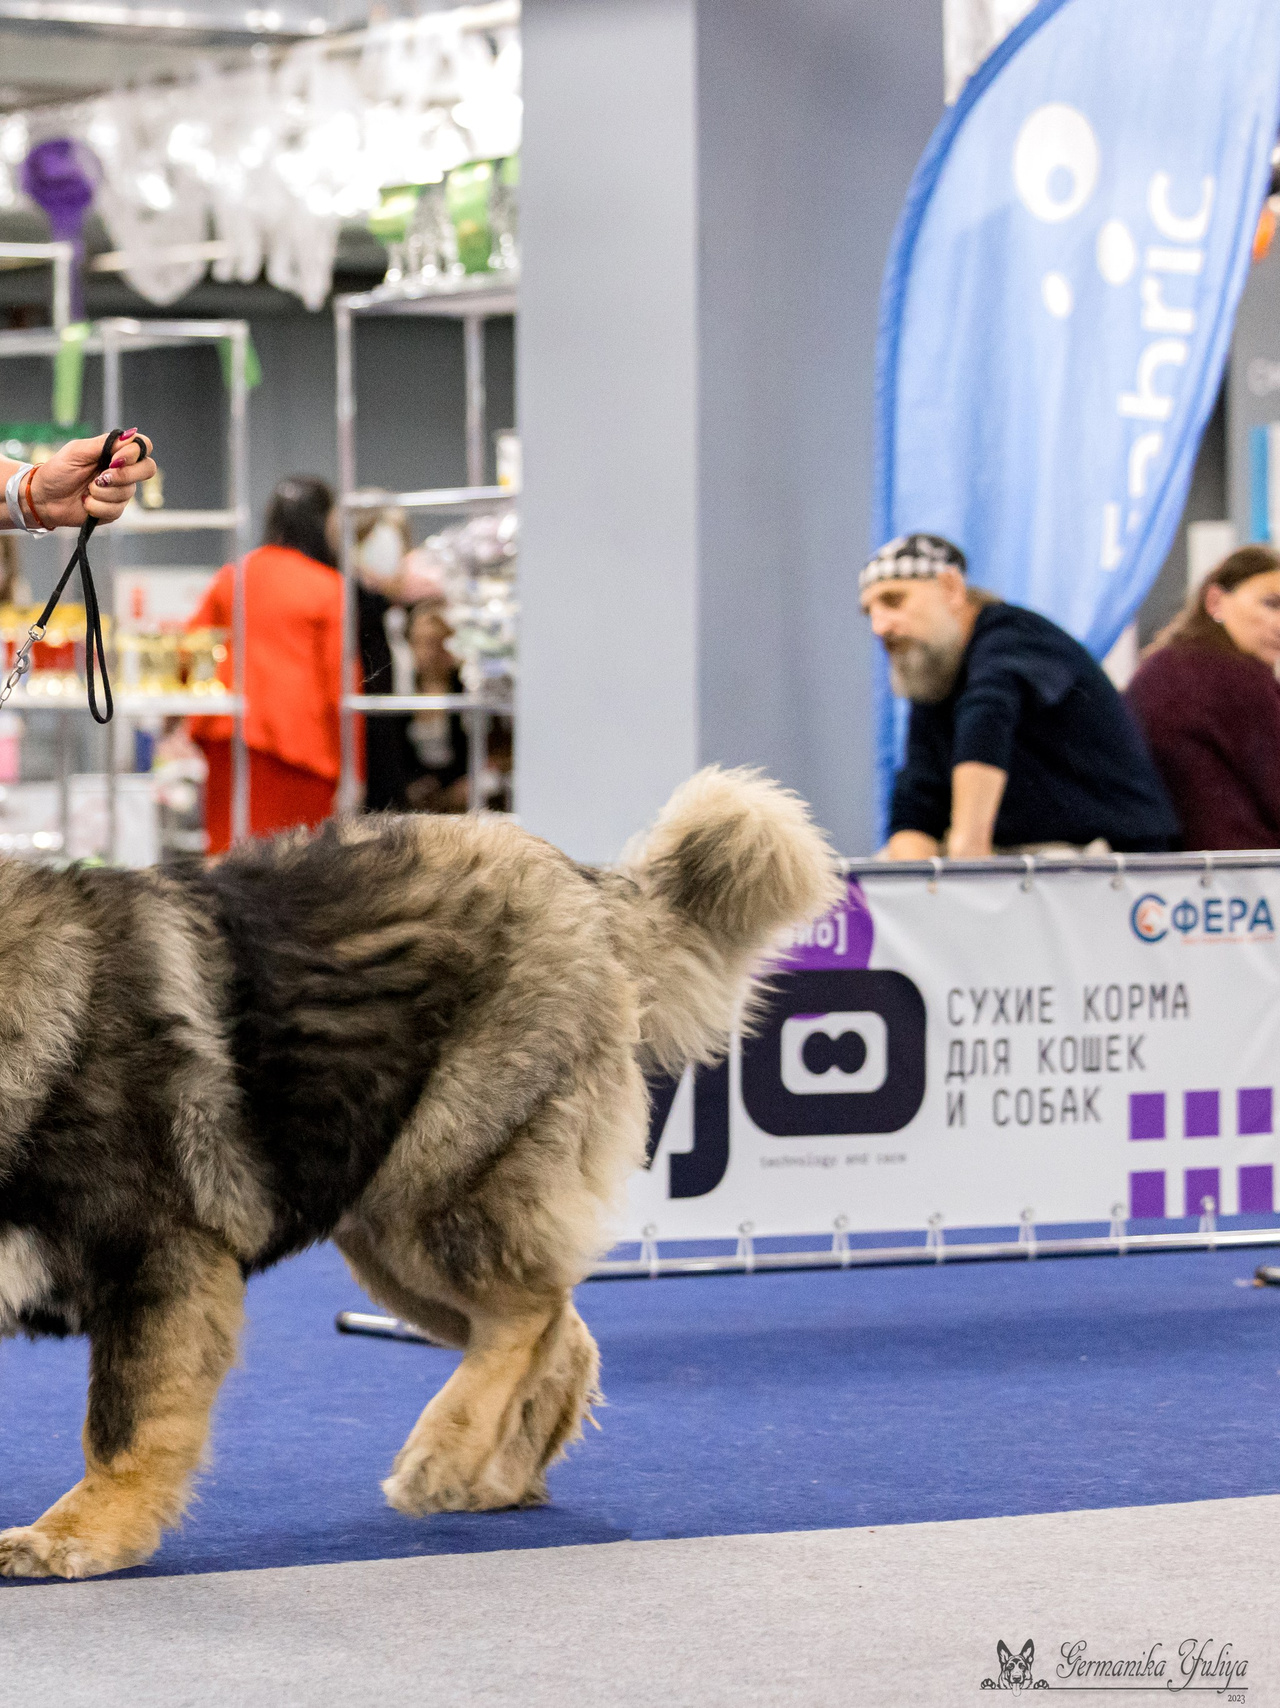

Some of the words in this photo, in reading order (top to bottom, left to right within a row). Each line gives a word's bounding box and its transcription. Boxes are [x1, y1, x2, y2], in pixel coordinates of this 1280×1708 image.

[1130, 893, 1276, 944] СФЕРА
[947, 985, 1055, 1026] СУХИЕ
[1083, 982, 1190, 1024] КОРМА
[945, 1038, 1010, 1083] ДЛЯ
[1038, 1034, 1146, 1074] КОШЕК
[946, 1090, 965, 1128] И
[992, 1086, 1101, 1127] СОБАК
